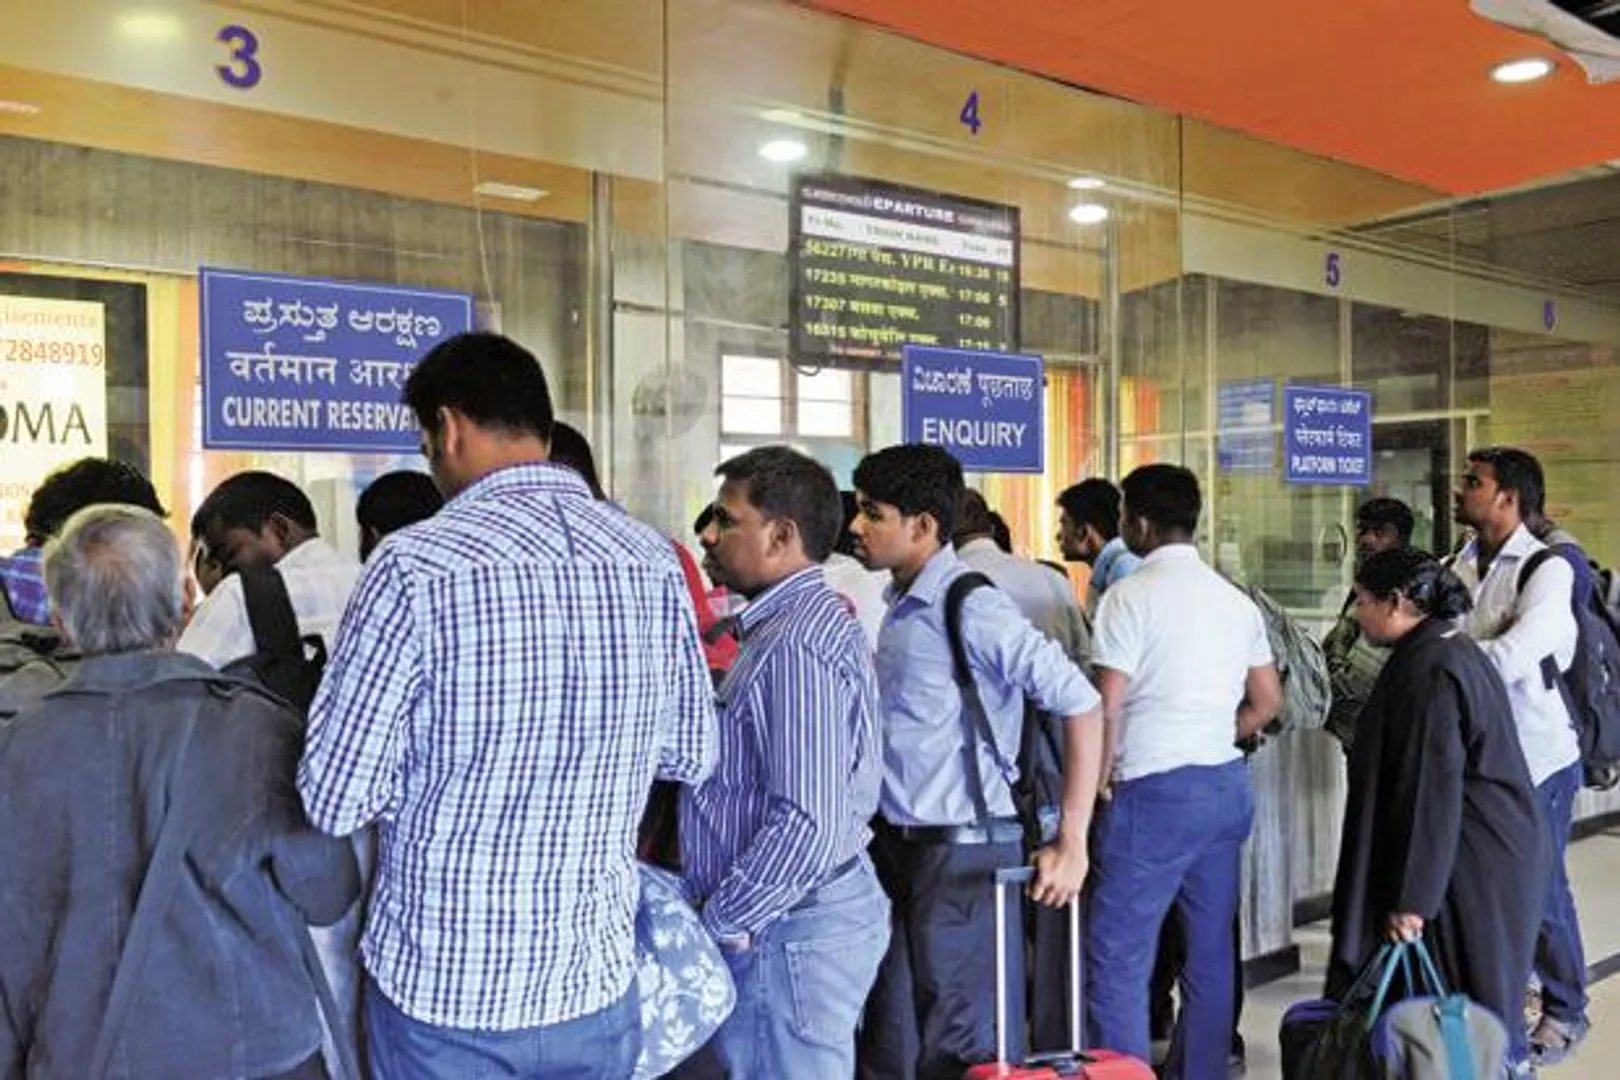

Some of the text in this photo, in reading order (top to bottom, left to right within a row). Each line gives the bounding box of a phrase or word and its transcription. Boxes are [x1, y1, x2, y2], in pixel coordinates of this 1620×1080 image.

[214, 25, 262, 89] 3
[959, 89, 982, 136] 4
[1325, 252, 1340, 287] 5
[225, 341, 338, 386] वर्तमान
[221, 395, 321, 430] CURRENT
[922, 416, 1027, 448] ENQUIRY
